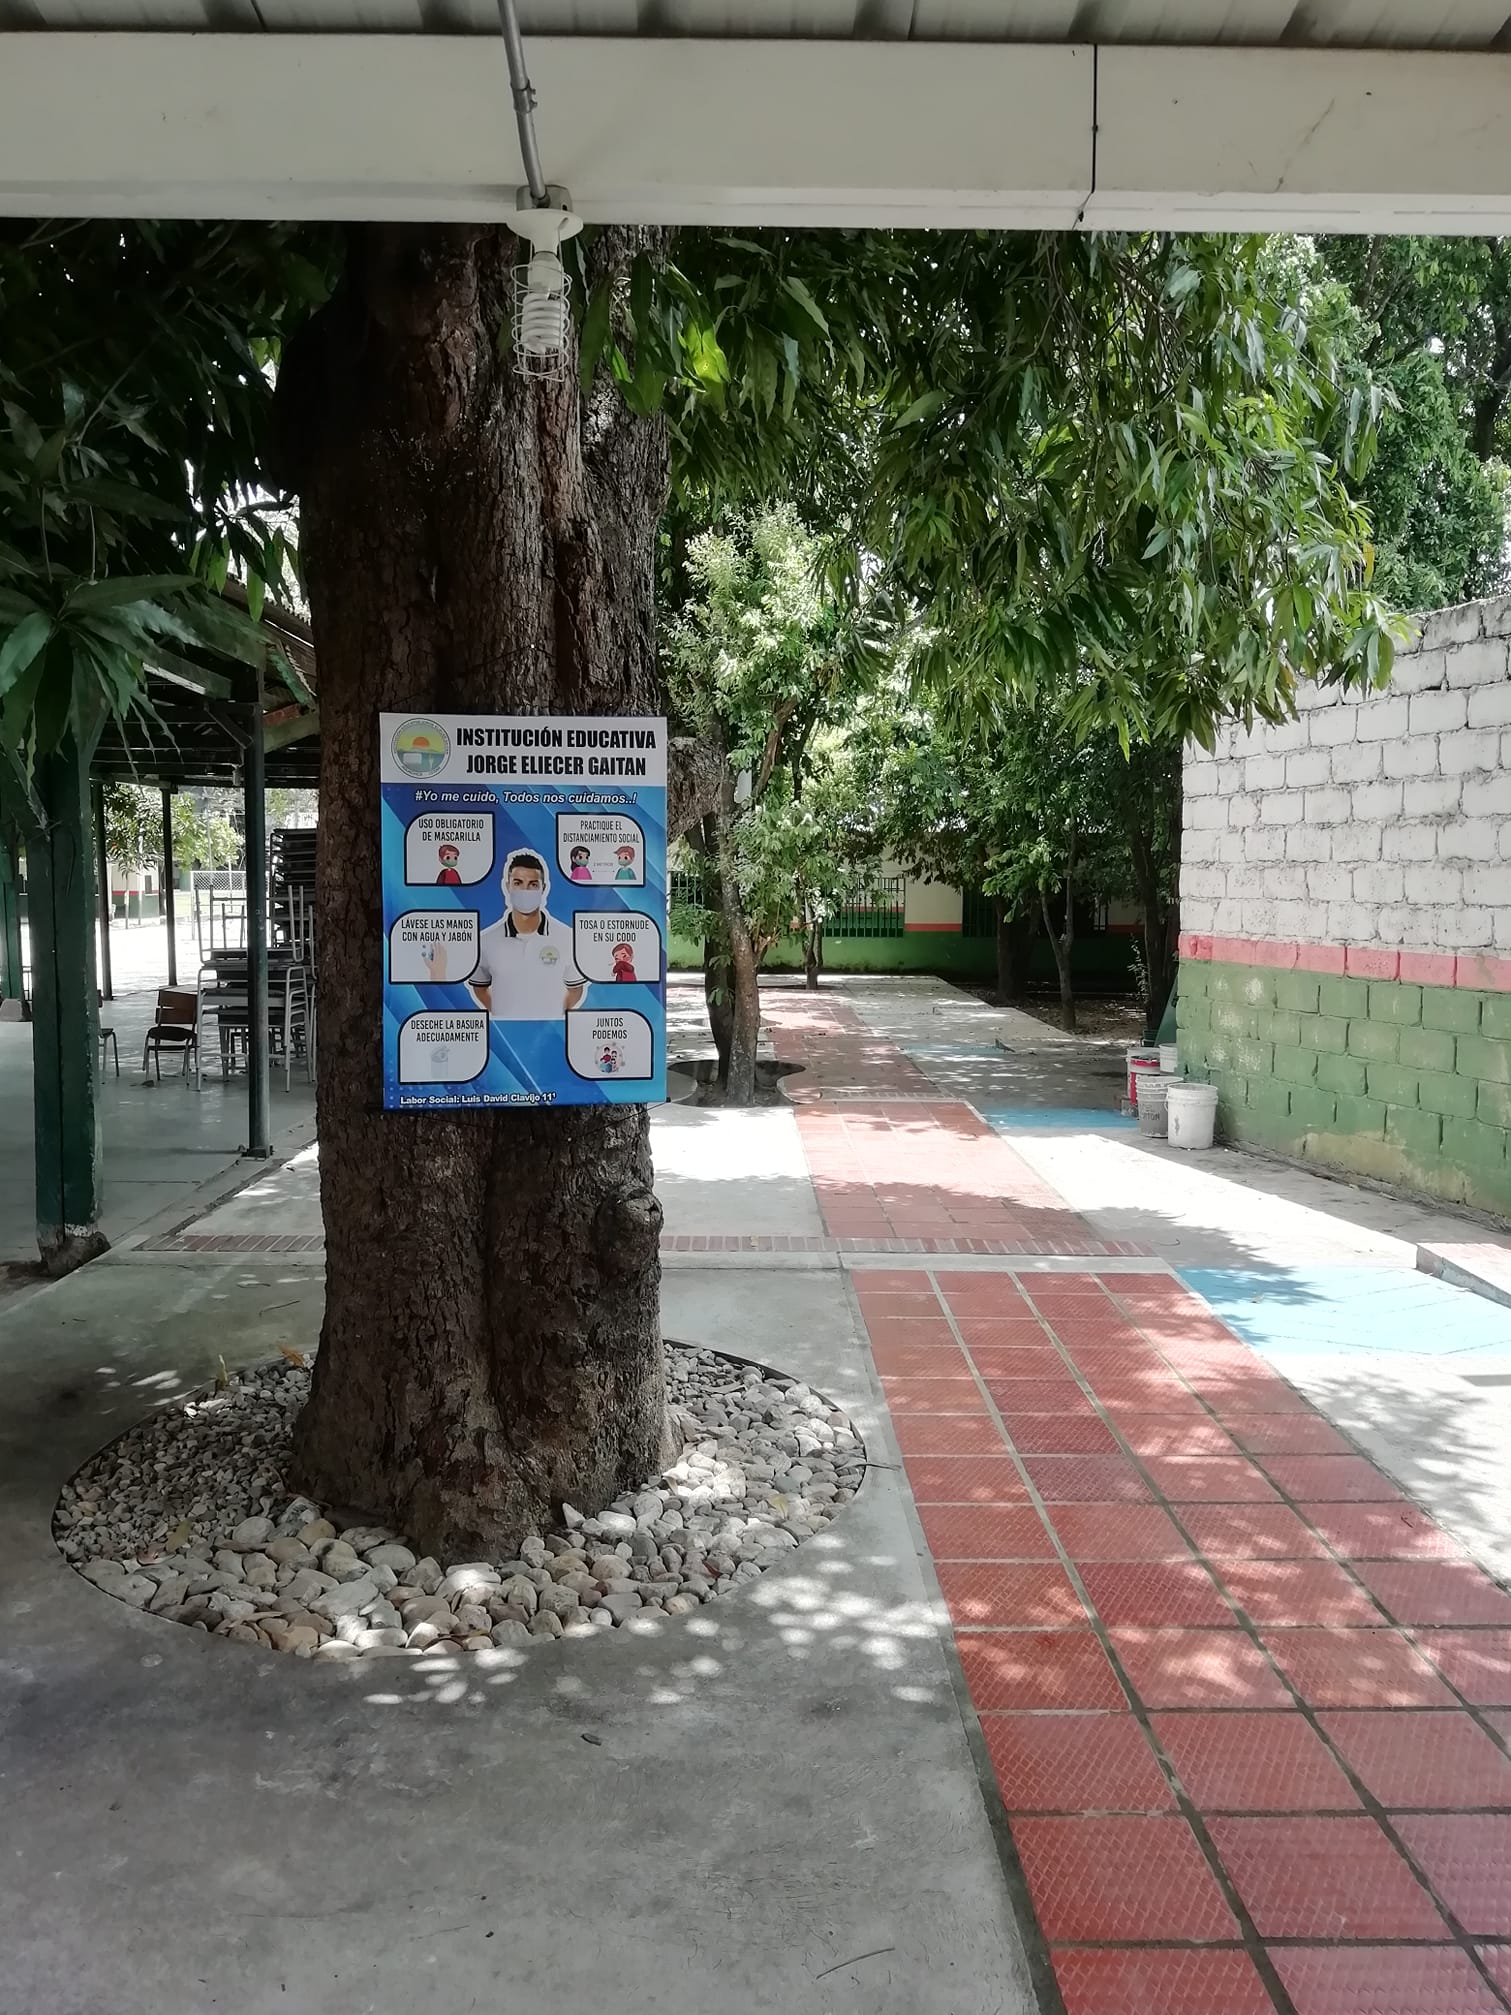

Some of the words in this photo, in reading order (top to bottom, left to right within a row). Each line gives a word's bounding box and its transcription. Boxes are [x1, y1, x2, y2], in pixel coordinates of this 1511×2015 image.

[457, 726, 562, 748] INSTITUCIÓN
[567, 729, 656, 749] EDUCATIVA
[467, 755, 517, 774] JORGE
[521, 756, 584, 775] ELIECER
[588, 757, 646, 776] GAITAN
[415, 790, 438, 801] #Yo
[441, 793, 460, 801] me
[463, 791, 499, 804] cuido,
[504, 791, 540, 802] Todos
[543, 794, 565, 803] nos
[418, 819, 433, 829] USO
[436, 819, 484, 829] OBLIGATORIO
[580, 821, 614, 830] PRACTIQUE
[615, 821, 623, 831] EL
[422, 832, 432, 842] DE
[434, 832, 481, 842] MASCARILLA
[563, 832, 617, 843] DISTANCIAMIENTO
[619, 833, 640, 843] SOCIAL
[401, 918, 428, 929] LÁVESE
[431, 920, 444, 929] LAS
[447, 920, 473, 929] MANOS
[580, 920, 598, 929] TOSA
[600, 920, 605, 929] O
[607, 920, 649, 929] ESTORNUDE
[402, 932, 417, 942] CON
[420, 932, 439, 942] AGUA
[440, 932, 447, 942] Y
[448, 931, 472, 942] JABÓN
[593, 933, 603, 942] EN
[605, 933, 615, 942] SU
[617, 933, 636, 942] CODO
[411, 1020, 443, 1030] DESECHE
[446, 1020, 455, 1029] LA
[457, 1020, 484, 1029] BASURA
[596, 1018, 624, 1028] JUNTOS
[416, 1032, 479, 1042] ADECUADAMENTE
[592, 1030, 628, 1040] PODEMOS
[400, 1096, 427, 1105] Labor
[428, 1095, 460, 1105] Social:
[461, 1095, 481, 1103] Luis
[483, 1094, 508, 1103] David
[511, 1093, 541, 1103] Clavijo
